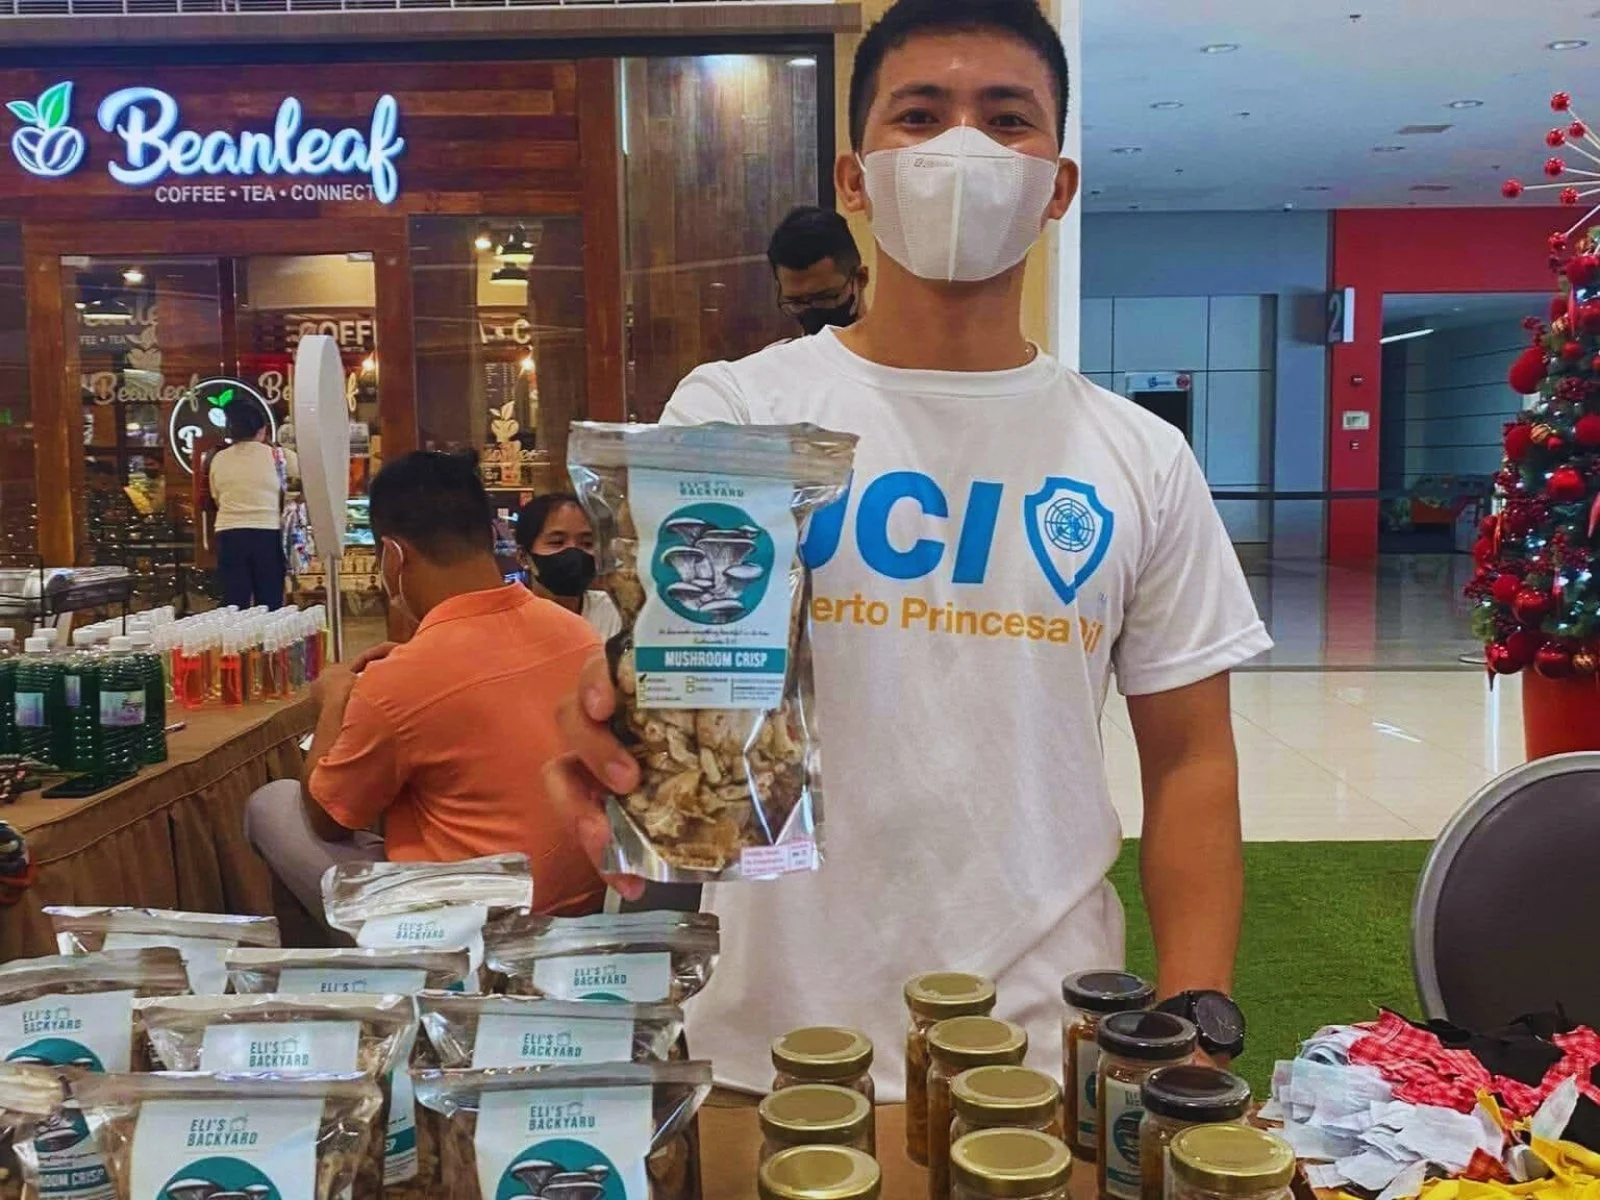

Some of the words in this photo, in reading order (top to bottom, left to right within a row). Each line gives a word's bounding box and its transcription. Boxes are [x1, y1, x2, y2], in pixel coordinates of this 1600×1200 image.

[97, 86, 404, 204] Beanleaf
[155, 186, 226, 203] COFFEE
[240, 186, 275, 202] TEA
[1327, 293, 1342, 343] 2
[809, 592, 890, 627] erto
[900, 596, 1071, 645] Princesa
[664, 651, 733, 668] MUSHROOM
[735, 651, 768, 668] CRISP
[573, 974, 628, 987] BACKYARD
[521, 1044, 582, 1058] BACKYARD
[249, 1053, 309, 1068] BACKYARD
[530, 1104, 563, 1119] ELI'S
[190, 1117, 226, 1133] ELI'S
[528, 1115, 596, 1131] BACKYARD
[187, 1131, 258, 1147] BACKYARD
